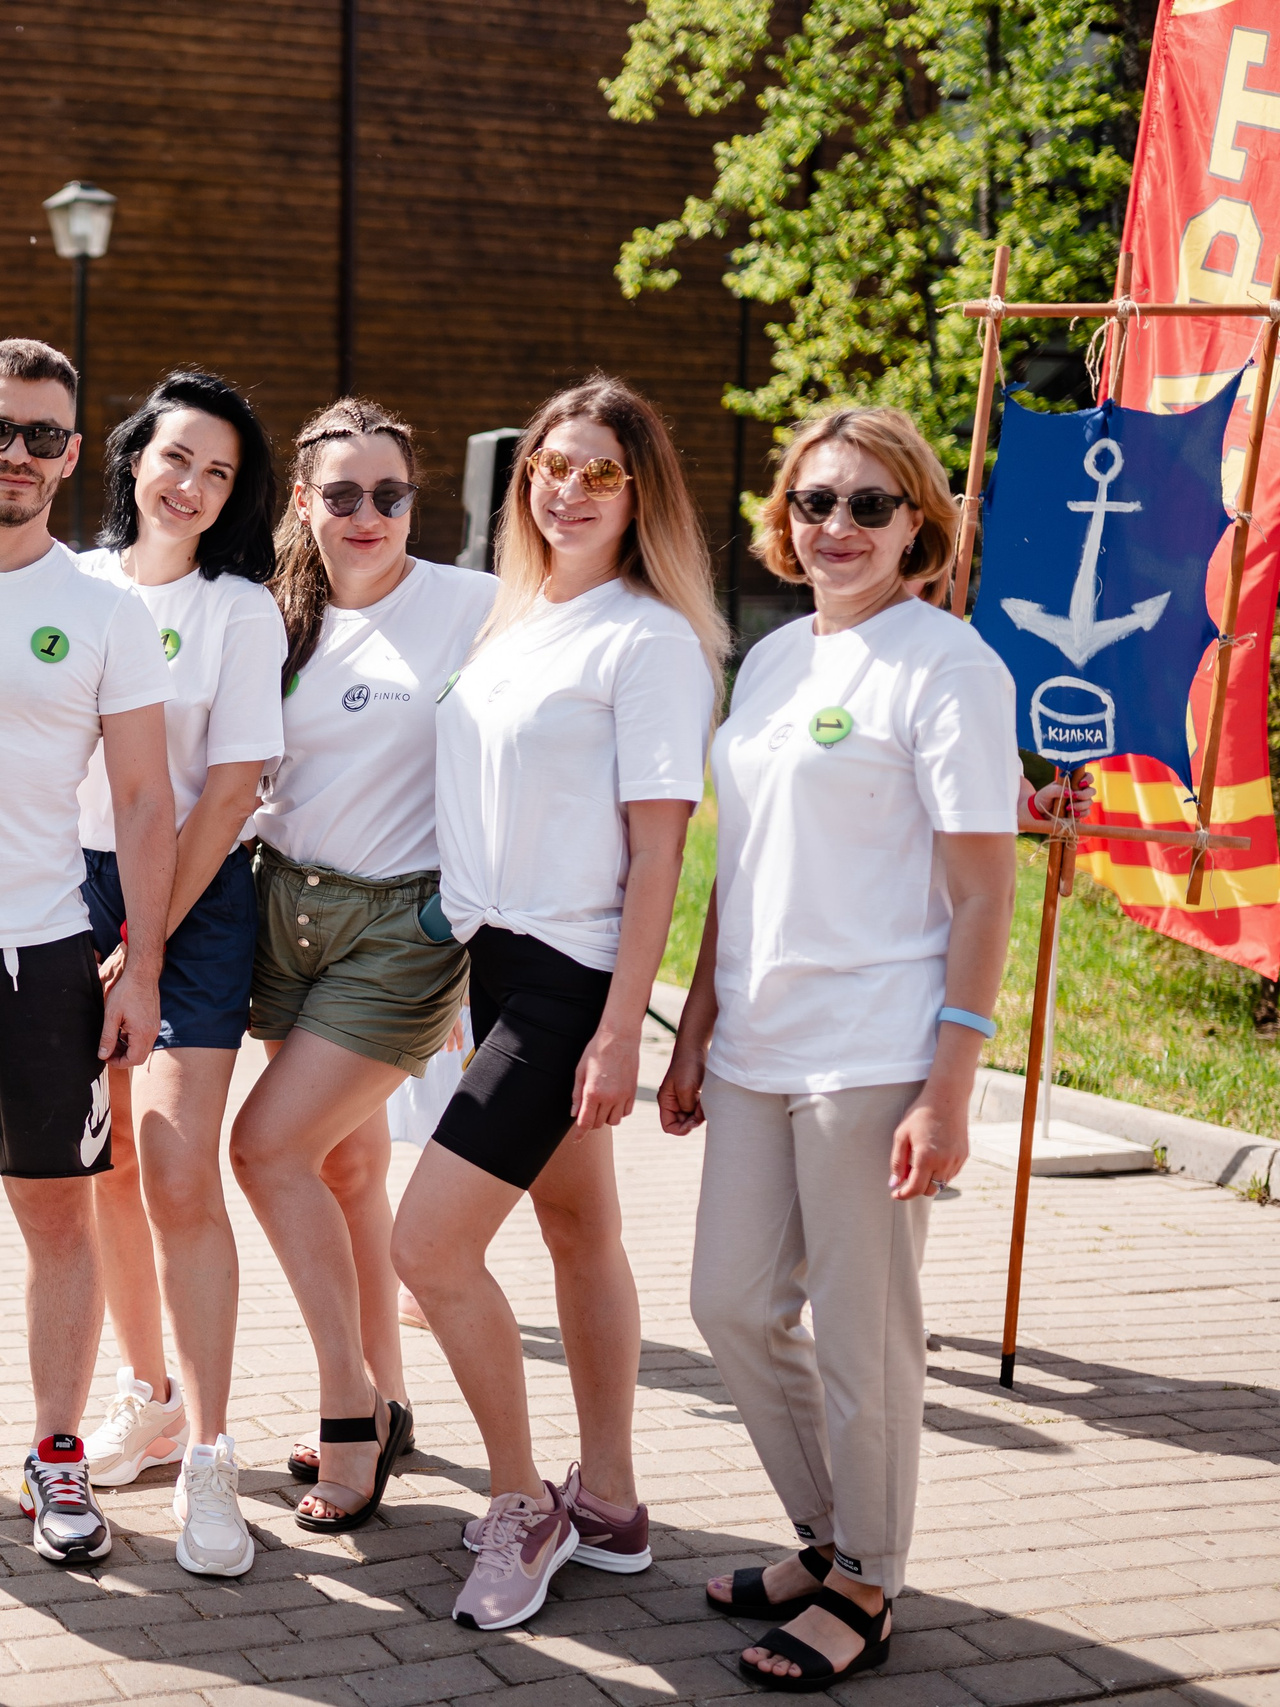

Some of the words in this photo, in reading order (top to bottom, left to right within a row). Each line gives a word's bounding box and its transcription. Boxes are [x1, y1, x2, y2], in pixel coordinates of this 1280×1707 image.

[40, 634, 61, 657] 1
[373, 692, 411, 702] FINIKO
[815, 717, 844, 732] 1
[1048, 725, 1104, 743] КИЛЬКА
